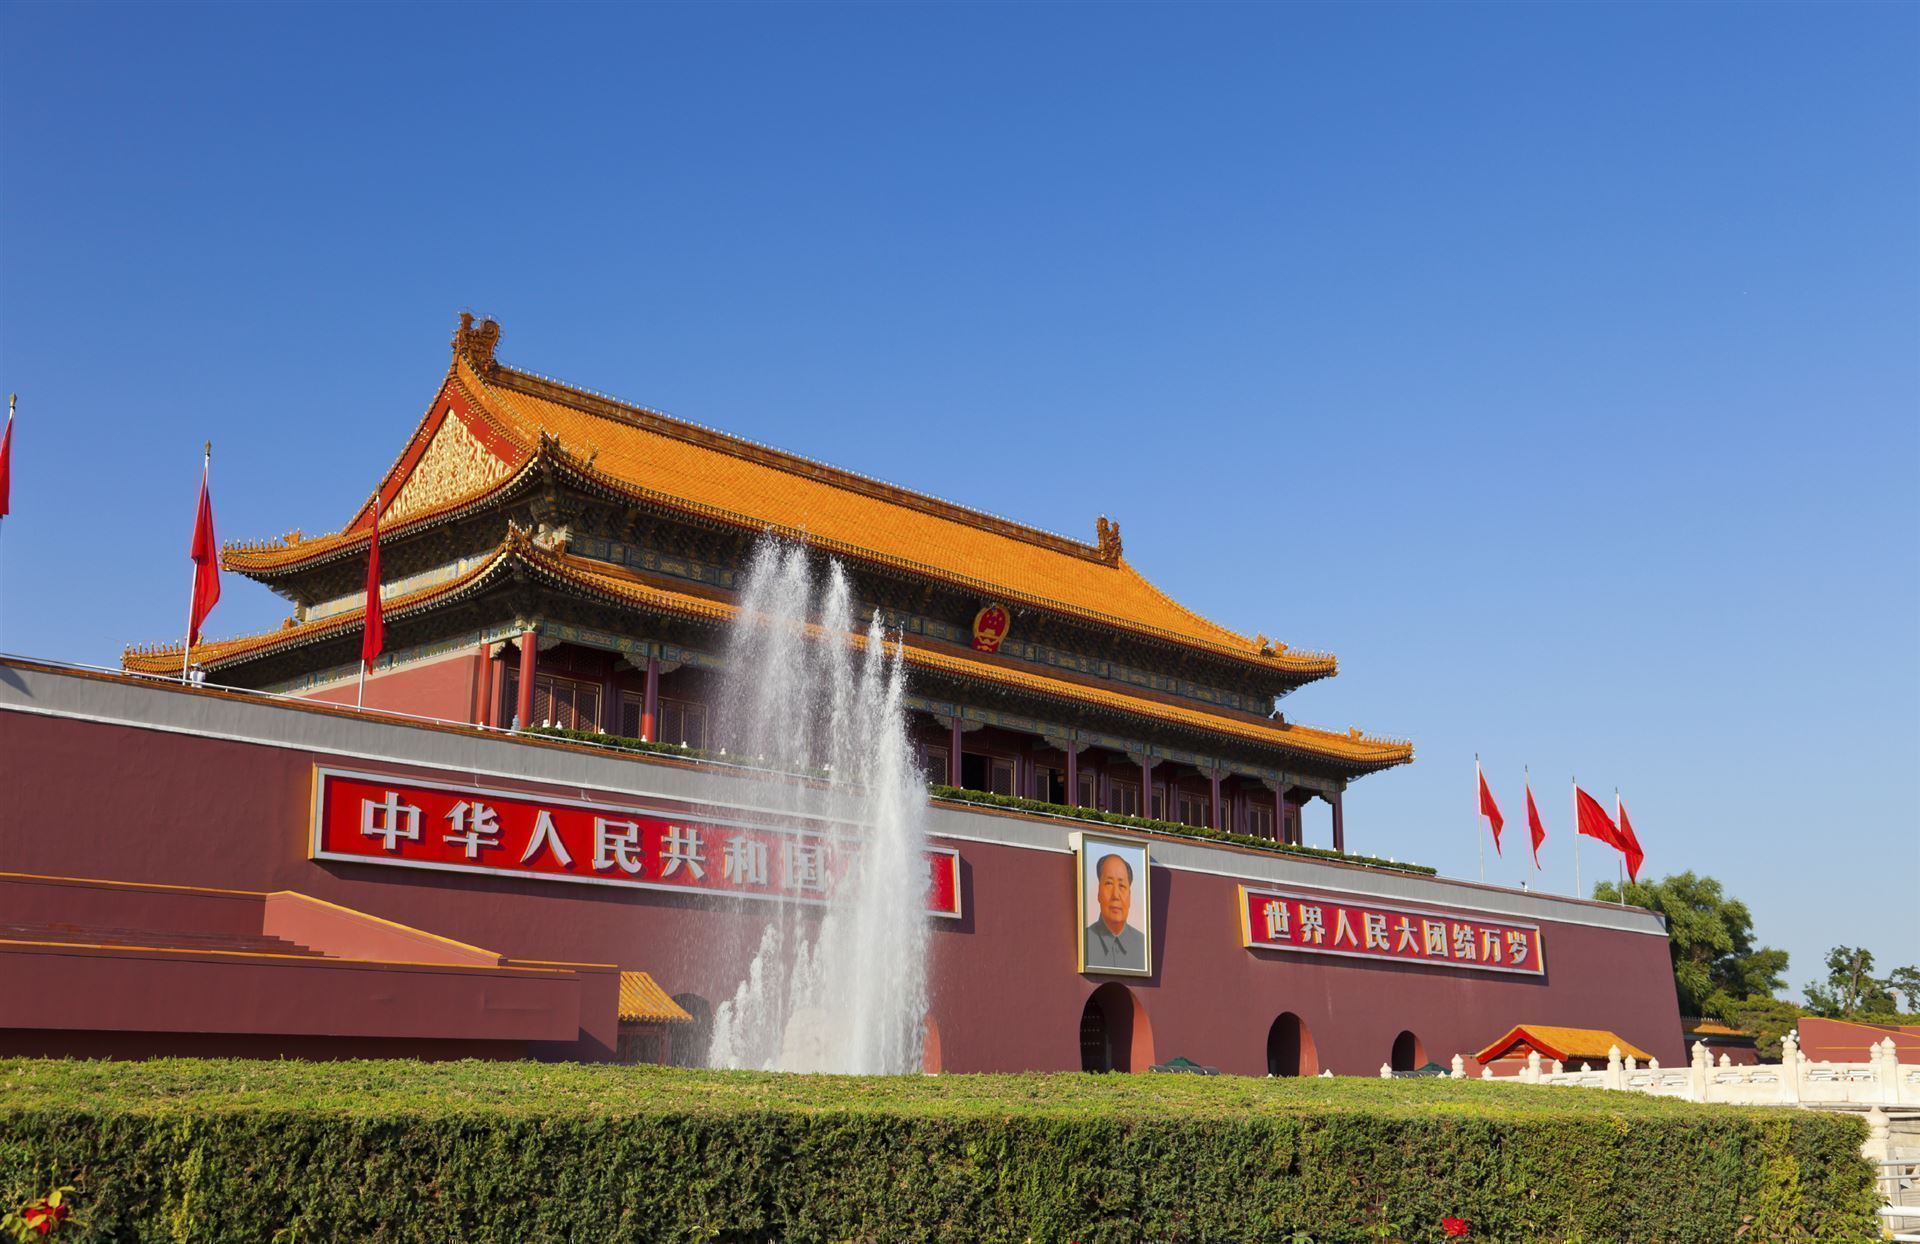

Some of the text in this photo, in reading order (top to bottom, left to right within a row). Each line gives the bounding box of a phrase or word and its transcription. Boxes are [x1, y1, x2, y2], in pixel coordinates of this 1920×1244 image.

[360, 791, 932, 902] 中华人民共和国
[1263, 900, 1528, 964] 世界人民大团结万岁
